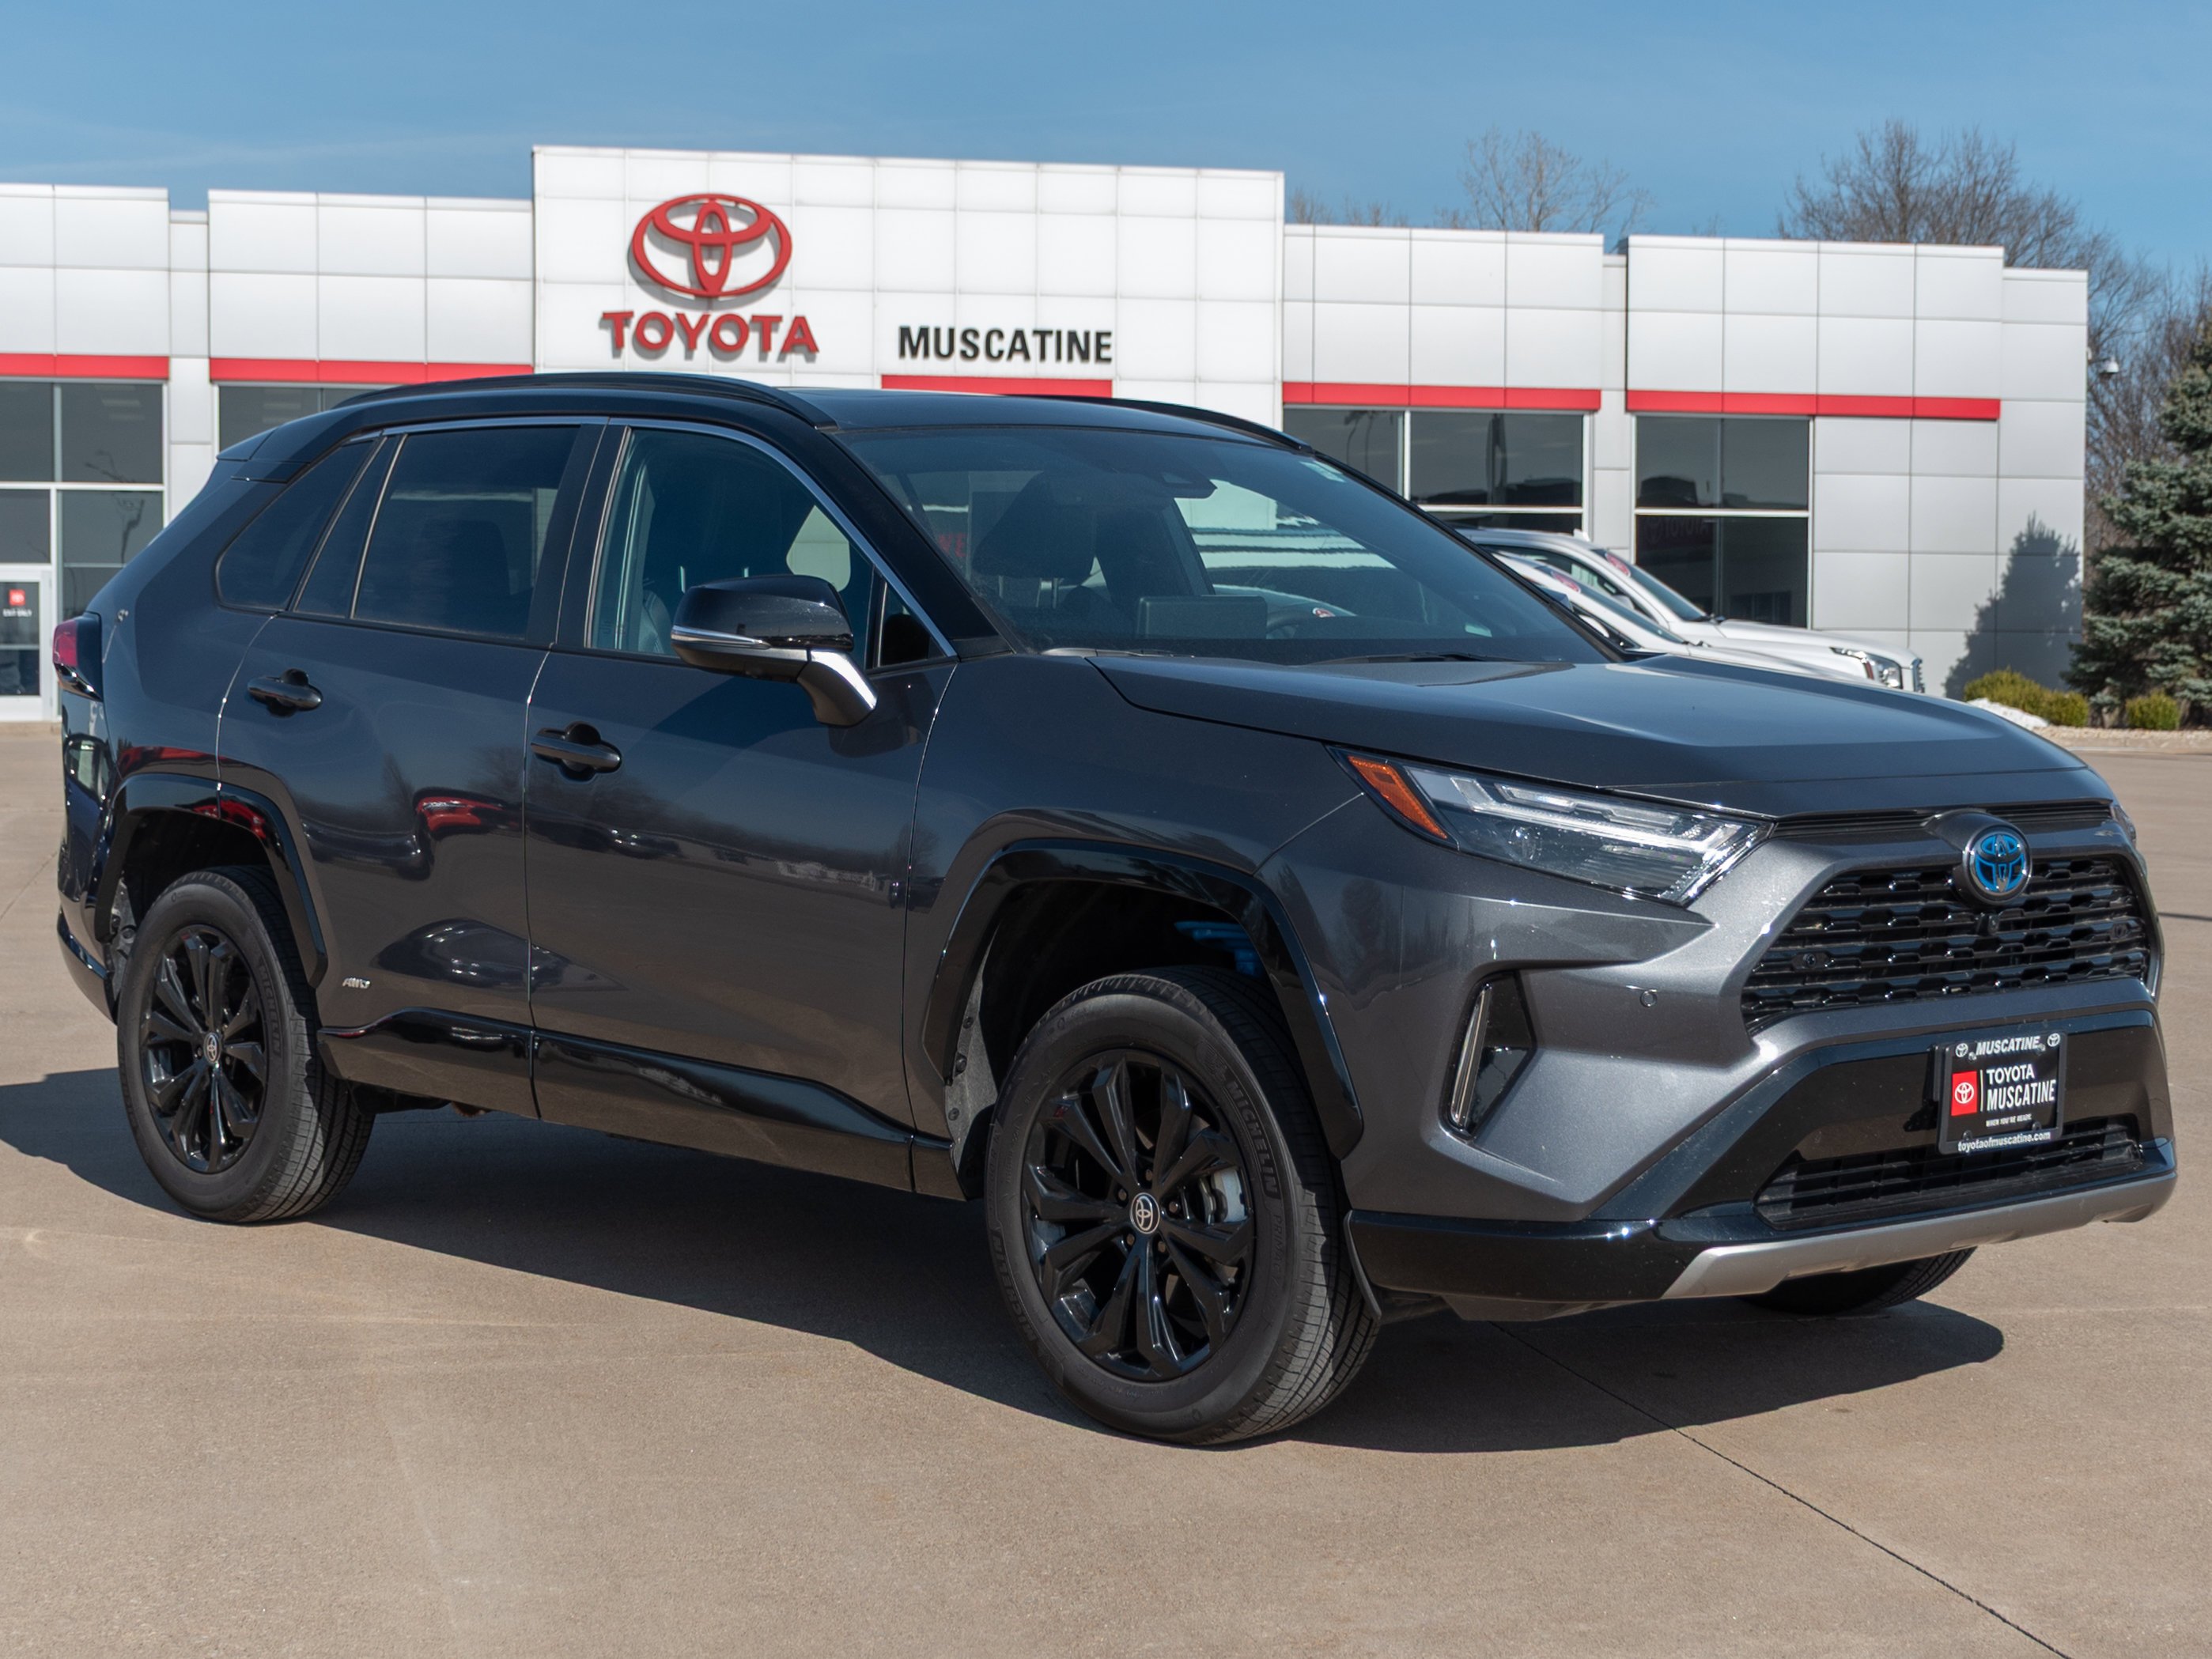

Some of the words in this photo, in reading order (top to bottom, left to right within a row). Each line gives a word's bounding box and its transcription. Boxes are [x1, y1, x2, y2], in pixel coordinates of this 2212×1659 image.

[602, 310, 819, 354] TOYOTA
[898, 325, 1114, 364] MUSCATINE
[1976, 1036, 2040, 1056] MUSCATINE
[1986, 1064, 2035, 1085] TOYOTA
[1986, 1079, 2056, 1112] MUSCATINE
[1226, 1080, 1278, 1194] MICHELIN
[1957, 1132, 2051, 1153] toyotaofmuscatine.com
[992, 1234, 1037, 1341] MICHELIN
